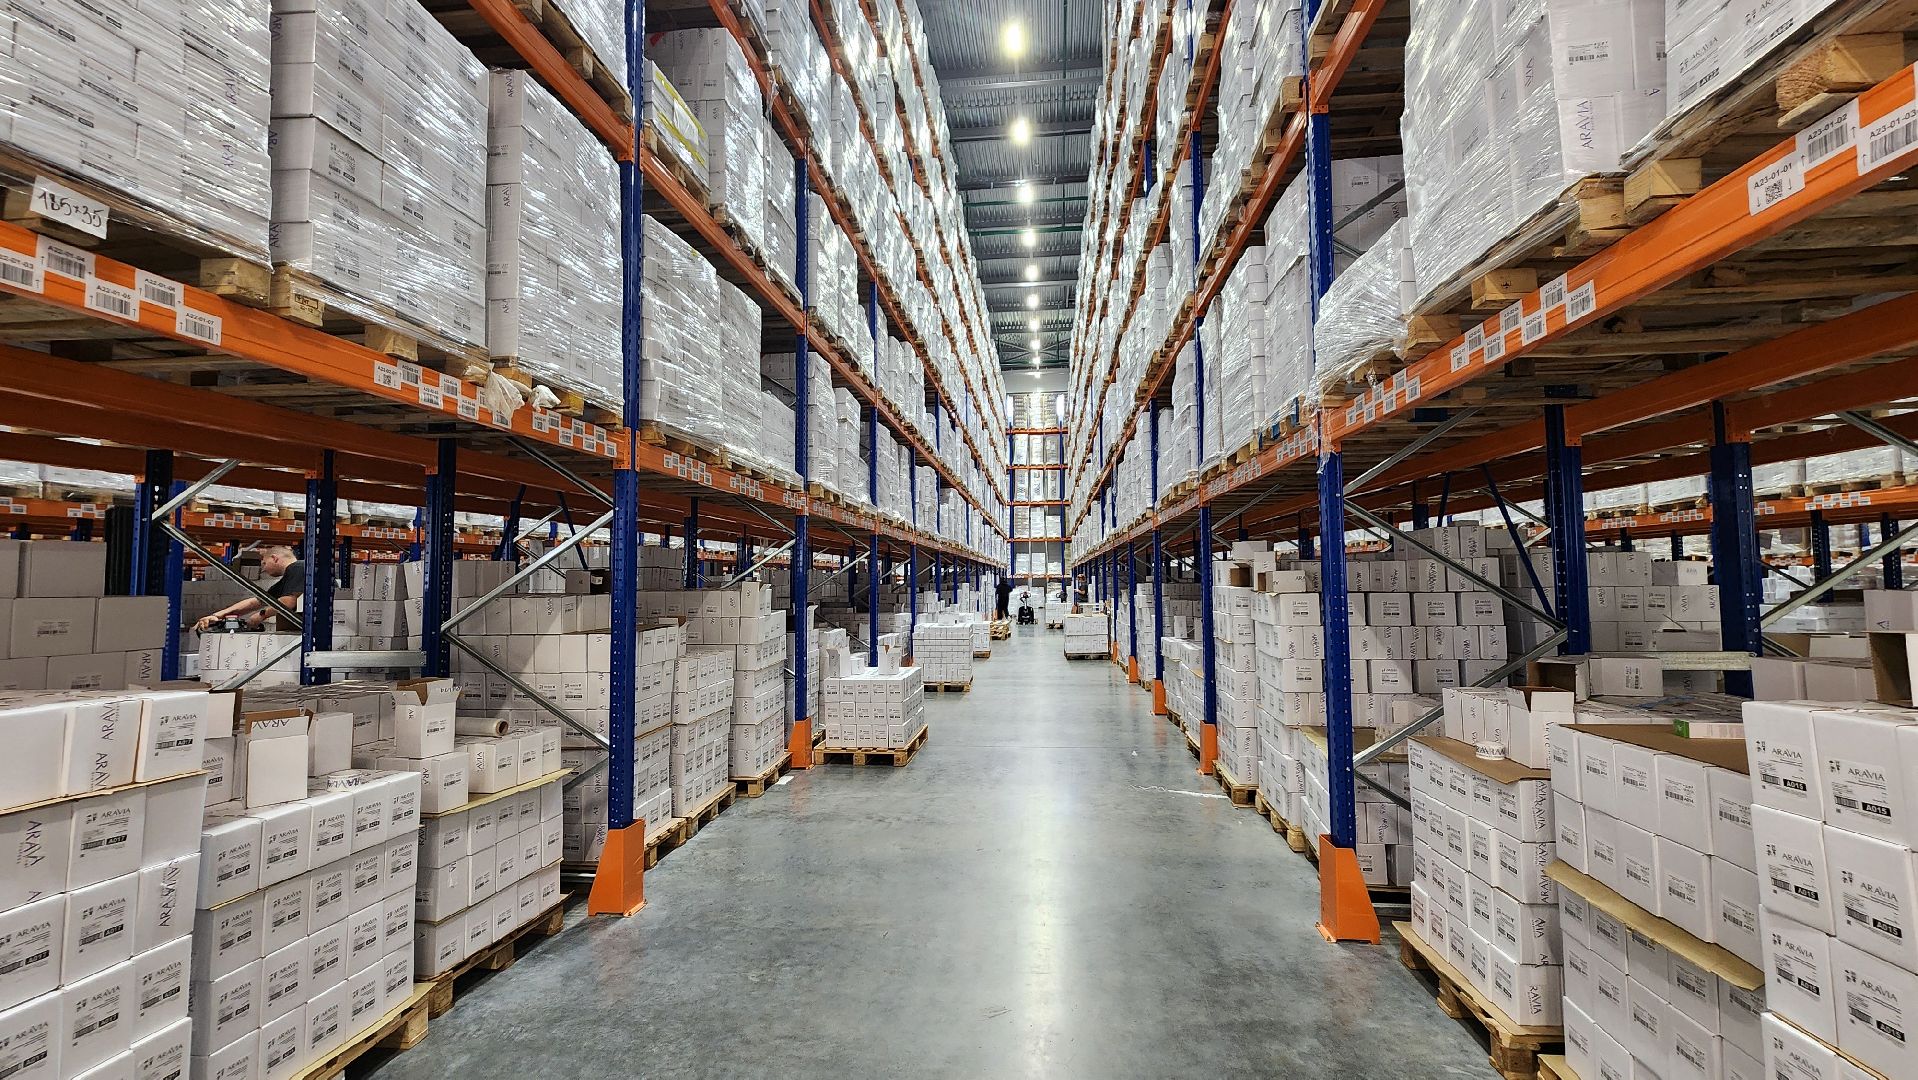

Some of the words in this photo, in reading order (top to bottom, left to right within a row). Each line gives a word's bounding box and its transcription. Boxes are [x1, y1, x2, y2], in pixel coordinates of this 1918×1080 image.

[1576, 100, 1593, 149] ARAVIA
[1807, 113, 1848, 142] A23-01-02
[1870, 109, 1917, 139] A23-01-03
[1753, 163, 1793, 190] A23-01-01
[171, 714, 197, 722] ARAVIA
[1771, 747, 1802, 759] ARAVIA
[1848, 767, 1886, 782] ARAVIA
[1784, 779, 1806, 791] A015
[101, 808, 131, 819] ARAVIA
[1864, 803, 1889, 816] A015
[327, 813, 345, 823] ARAVIA
[107, 836, 126, 845] A017
[279, 828, 299, 838] ARAVIA
[22, 820, 45, 868] ARAVIA
[229, 842, 251, 854] ARAVIA
[1782, 853, 1813, 868] ARAVIA
[282, 890, 302, 901] ARAVIA
[1796, 886, 1817, 900] A015
[1860, 882, 1898, 902] ARAVIA
[97, 897, 126, 911] ARAVIA
[232, 909, 253, 921] ARAVIA
[15, 921, 52, 938] ARAVIA
[105, 925, 123, 937] A017
[1875, 919, 1900, 937] A015
[26, 951, 48, 964] A017
[1785, 942, 1814, 959] ARAVIA
[155, 960, 182, 977] ARAVIA
[279, 961, 299, 974] ARAVIA
[91, 986, 120, 1002] ARAVIA
[231, 982, 252, 995] ARAVIA
[1800, 979, 1819, 995] A015
[1860, 980, 1898, 1002] ARAVIA
[15, 1021, 49, 1041] ARAVIA
[277, 1026, 297, 1039] ARAVIA
[1879, 1022, 1903, 1040] A015
[156, 1044, 183, 1060] ARAVIA
[1789, 1052, 1822, 1076] ARAVIA
